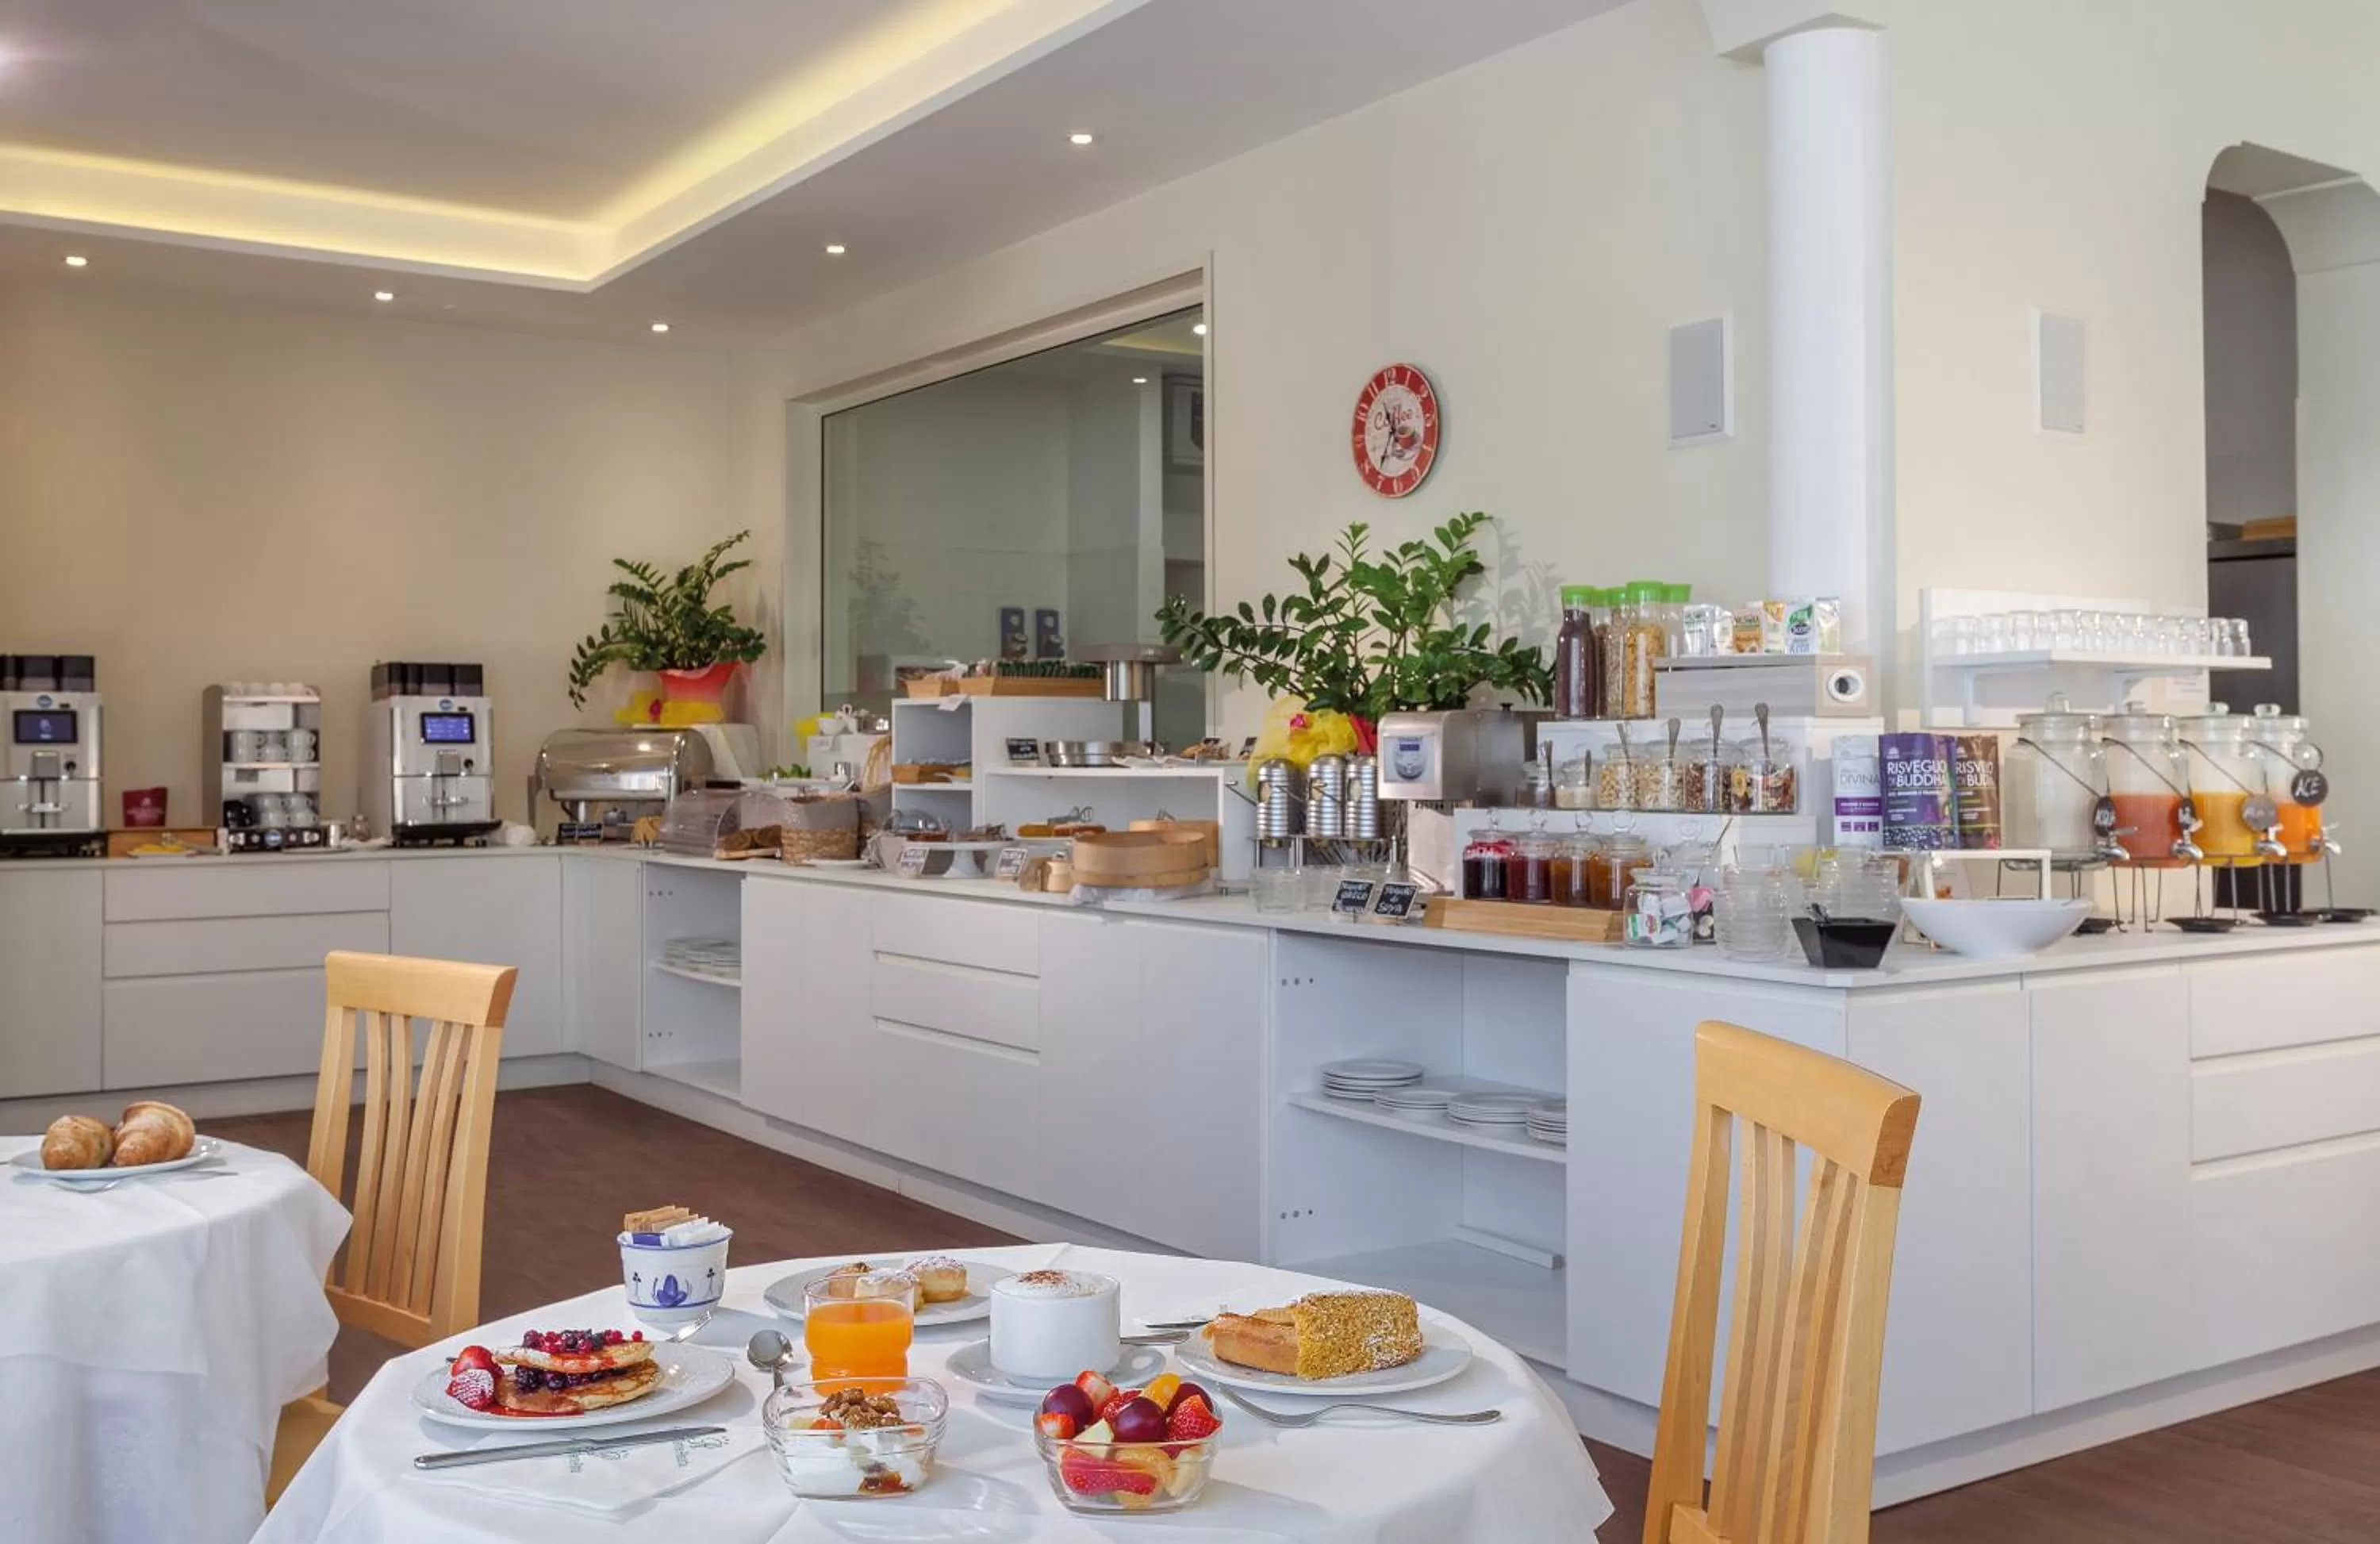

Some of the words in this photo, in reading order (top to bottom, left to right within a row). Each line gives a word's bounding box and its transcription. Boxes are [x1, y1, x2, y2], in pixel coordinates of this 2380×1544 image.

[1383, 367, 1396, 386] 12
[1405, 371, 1411, 386] 1
[1368, 382, 1380, 399] 11
[1840, 774, 1880, 785] DIVINA
[2294, 776, 2320, 797] ACE
